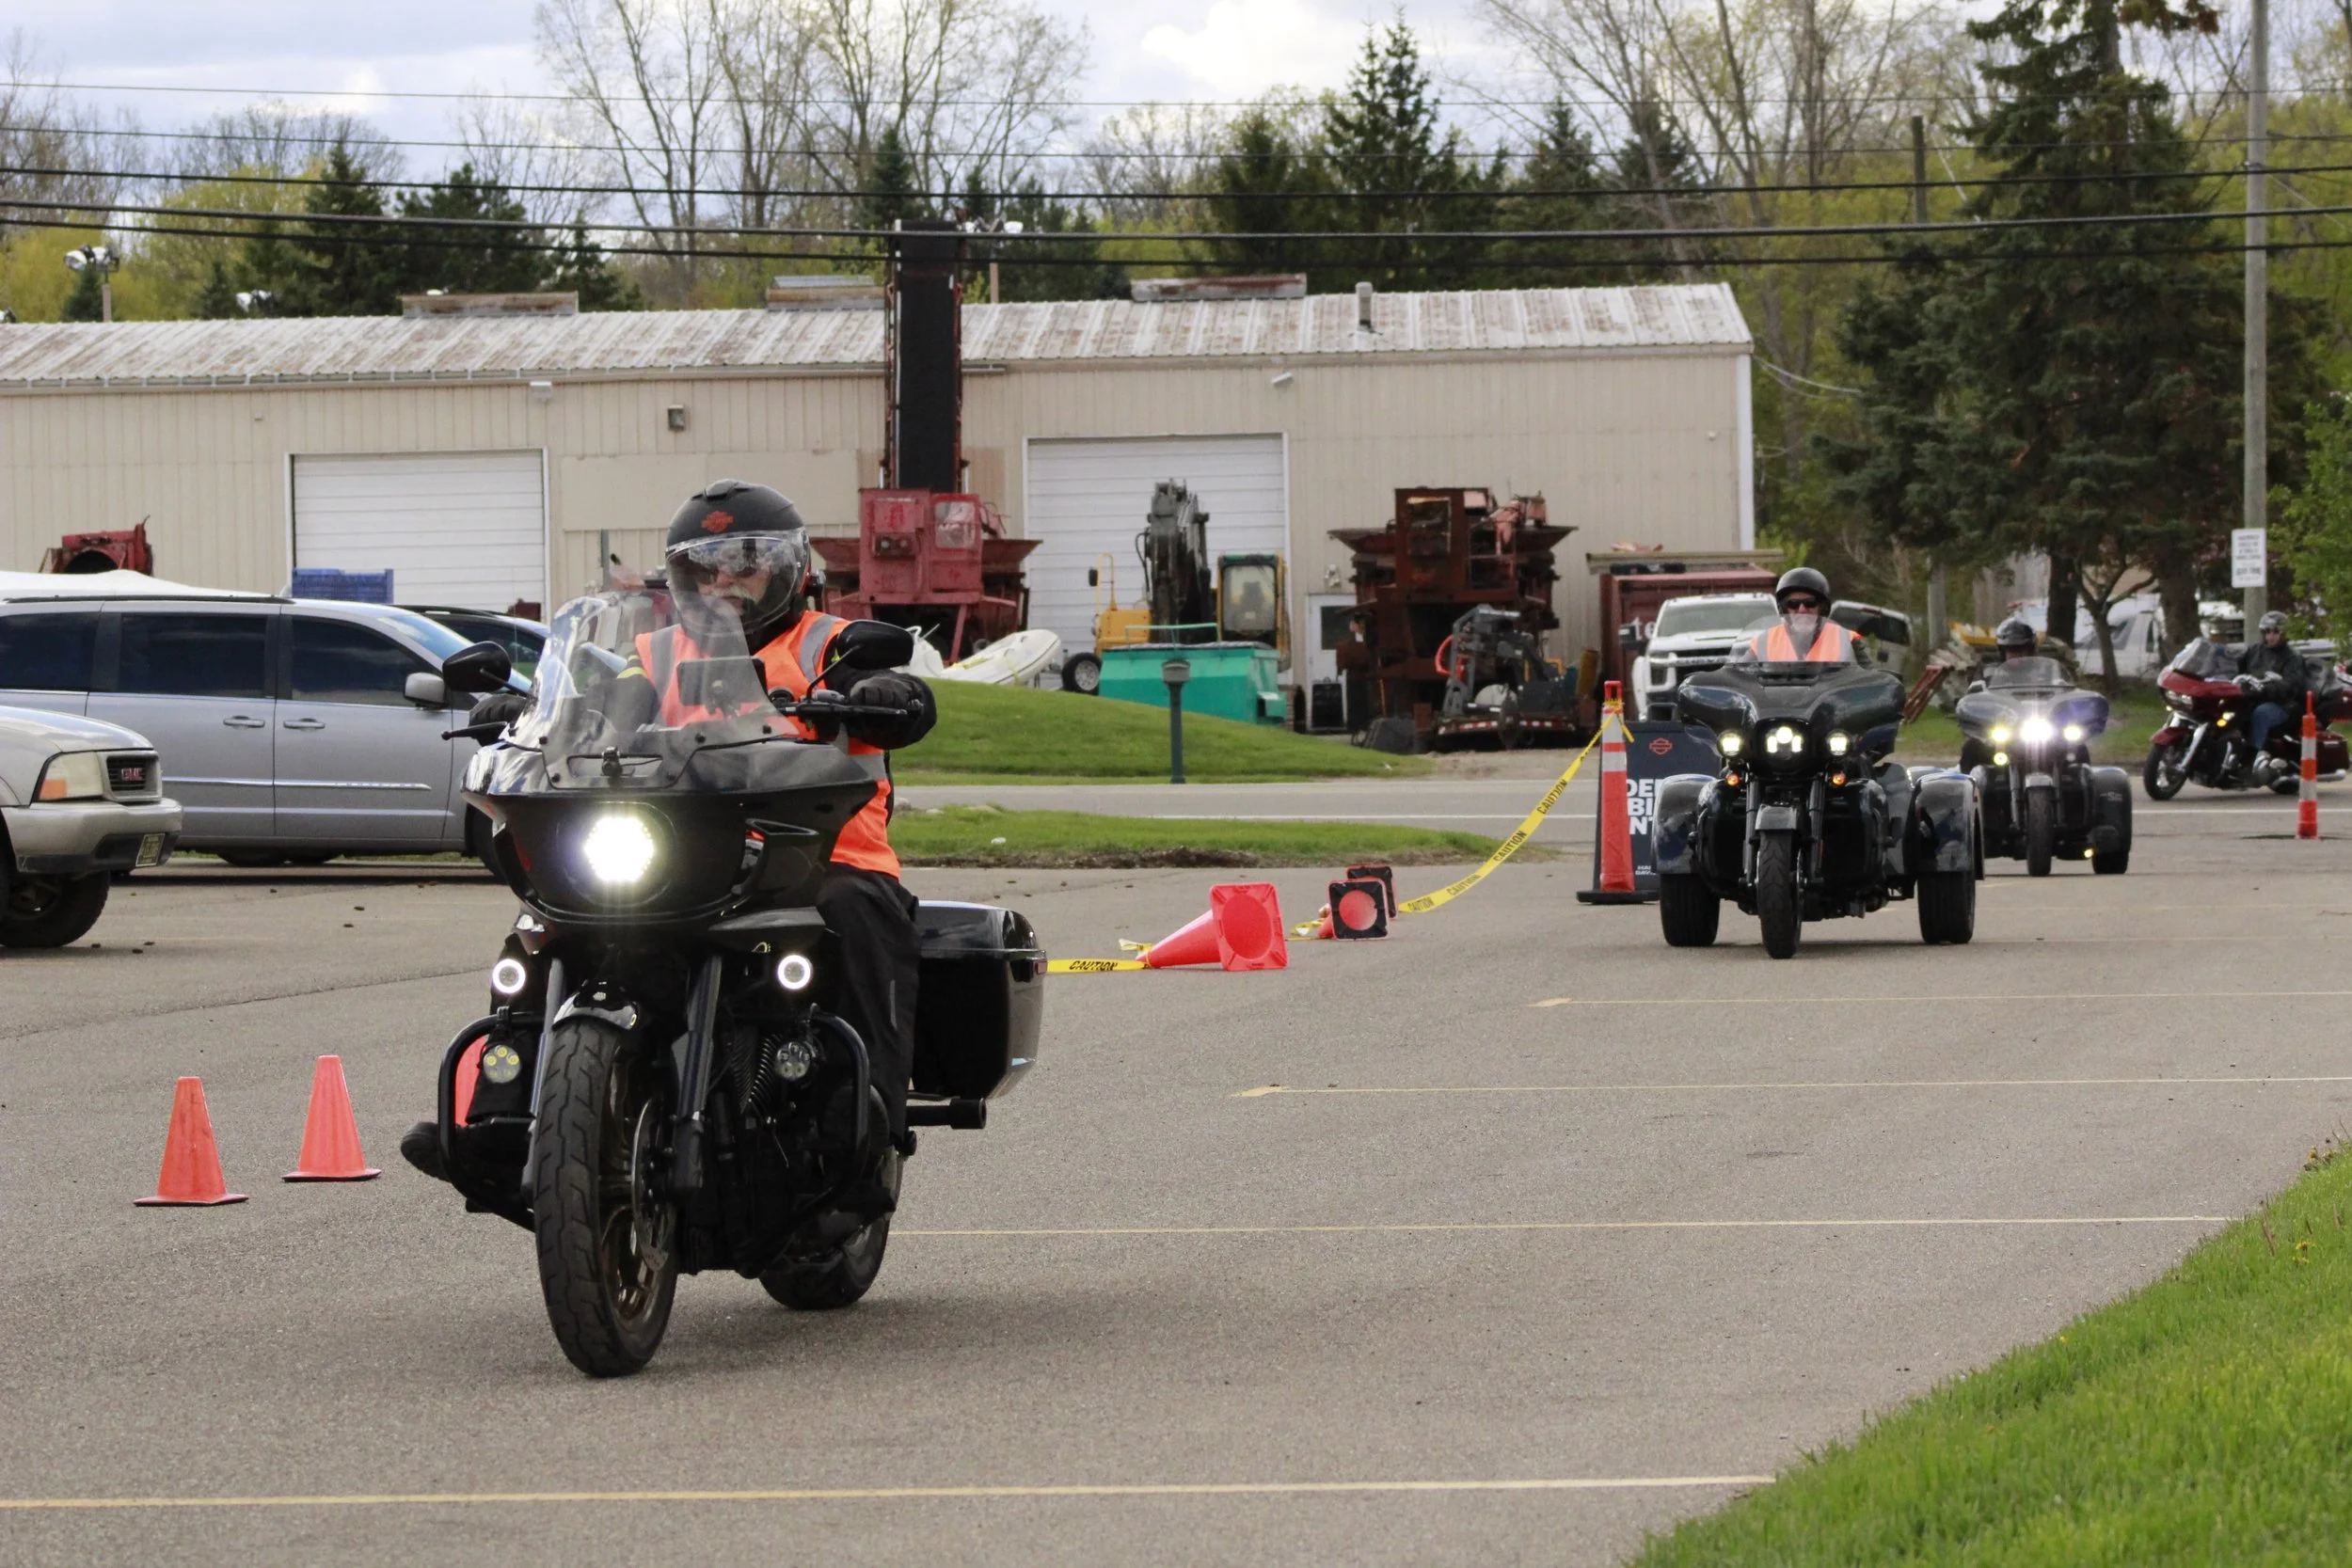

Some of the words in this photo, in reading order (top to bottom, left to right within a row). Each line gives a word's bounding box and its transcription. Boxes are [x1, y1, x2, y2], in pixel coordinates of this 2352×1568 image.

[1407, 895, 1435, 911] CAUTION
[1446, 874, 1481, 896] CAUTION
[1493, 830, 1528, 863] CAUTION
[1536, 779, 1567, 816] CAUTION
[1069, 960, 1118, 972] CAUTION
